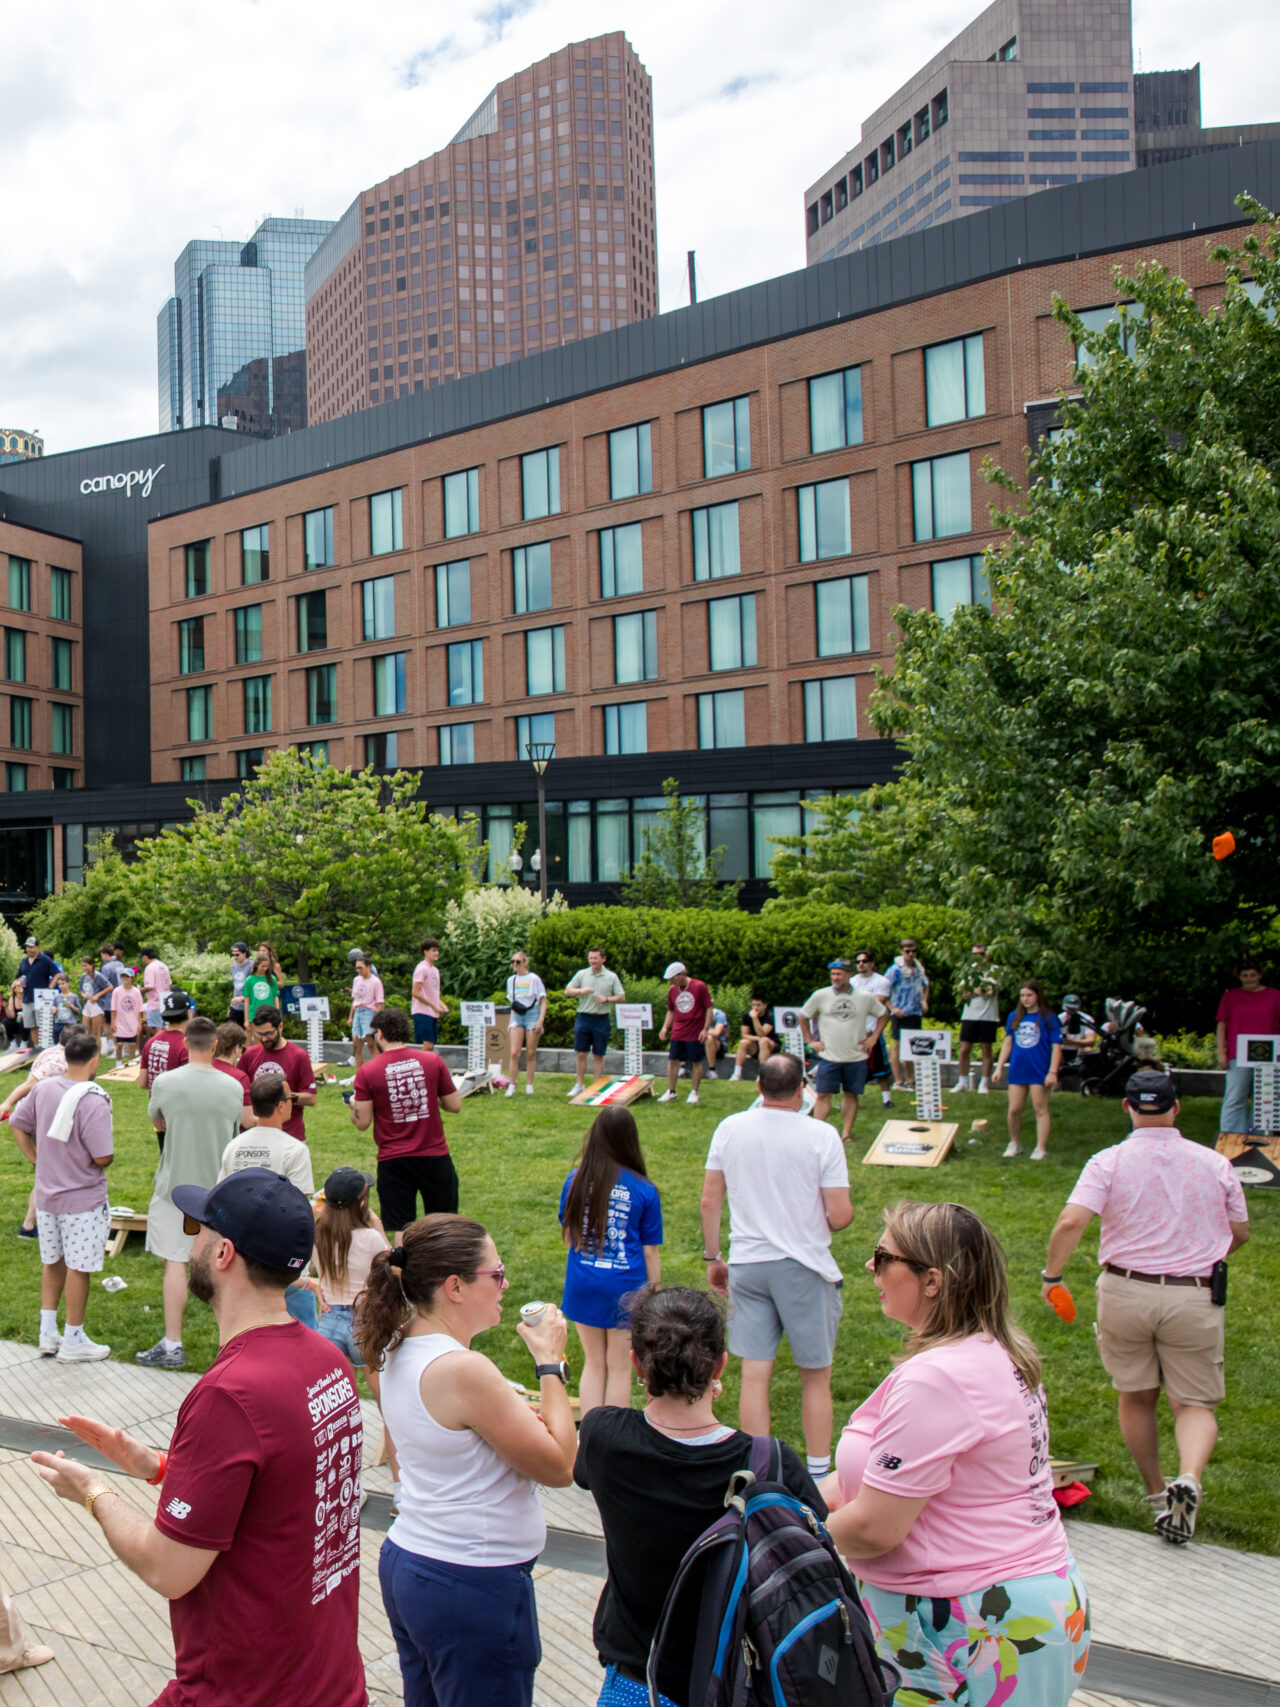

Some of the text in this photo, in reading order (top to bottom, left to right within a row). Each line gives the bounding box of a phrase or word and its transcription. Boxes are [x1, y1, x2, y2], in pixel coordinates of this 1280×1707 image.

[80, 463, 165, 497] canopy
[235, 1150, 271, 1158] SPONSORS
[308, 1376, 354, 1423] SPONSORS
